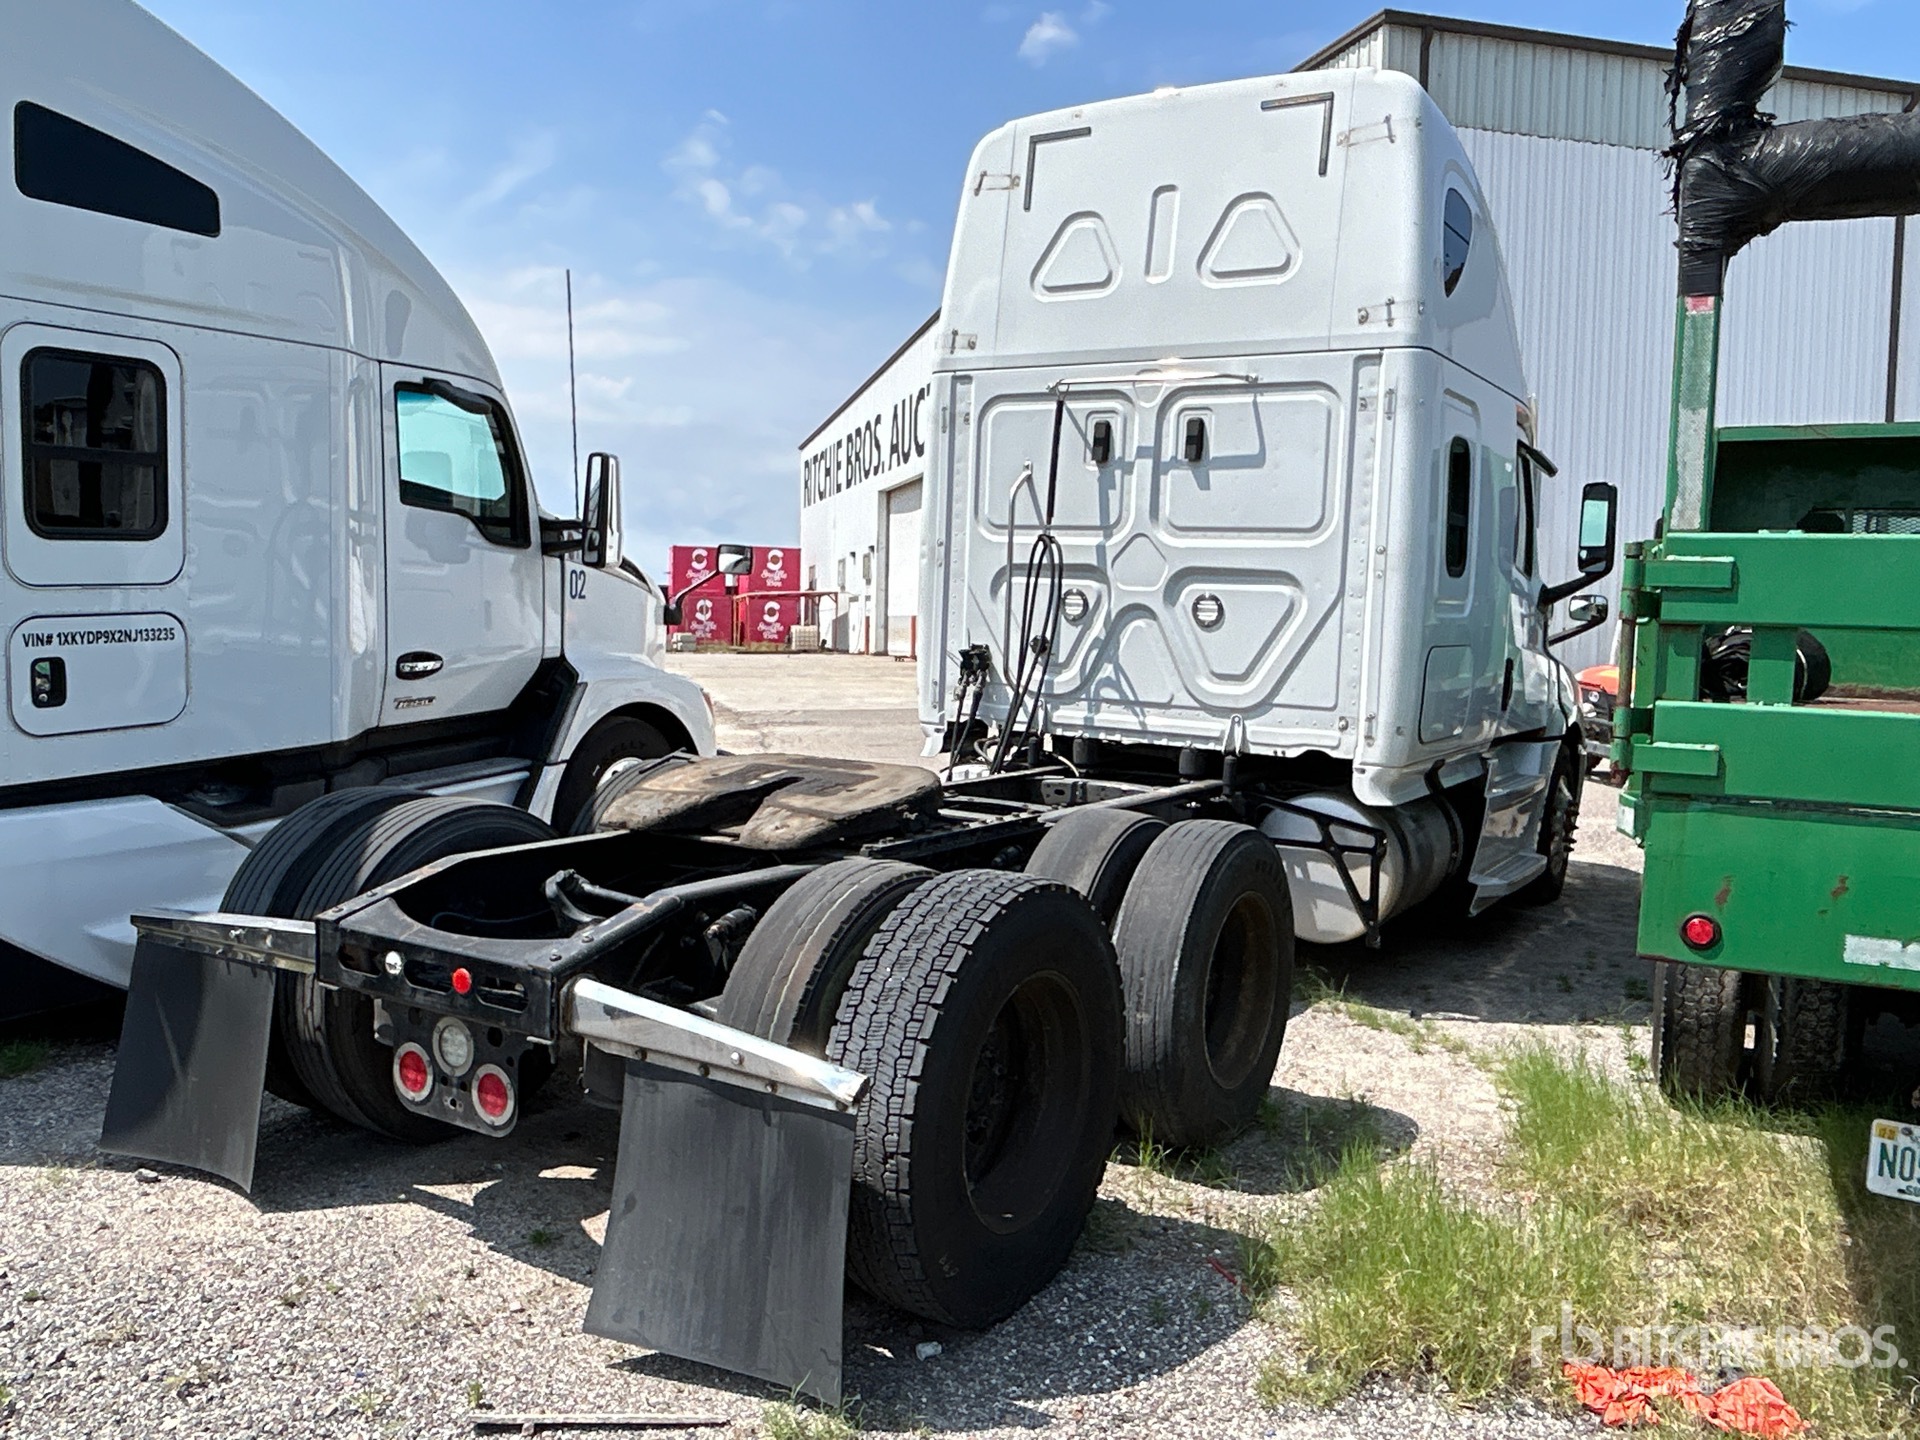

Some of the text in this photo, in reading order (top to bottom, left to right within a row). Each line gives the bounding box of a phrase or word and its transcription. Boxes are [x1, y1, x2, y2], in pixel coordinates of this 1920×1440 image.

[803, 383, 931, 508] RITCHIE BROS. AUC
[570, 569, 586, 600] 02
[22, 627, 175, 648] VIN# 1XKYDP9X2NJ133235
